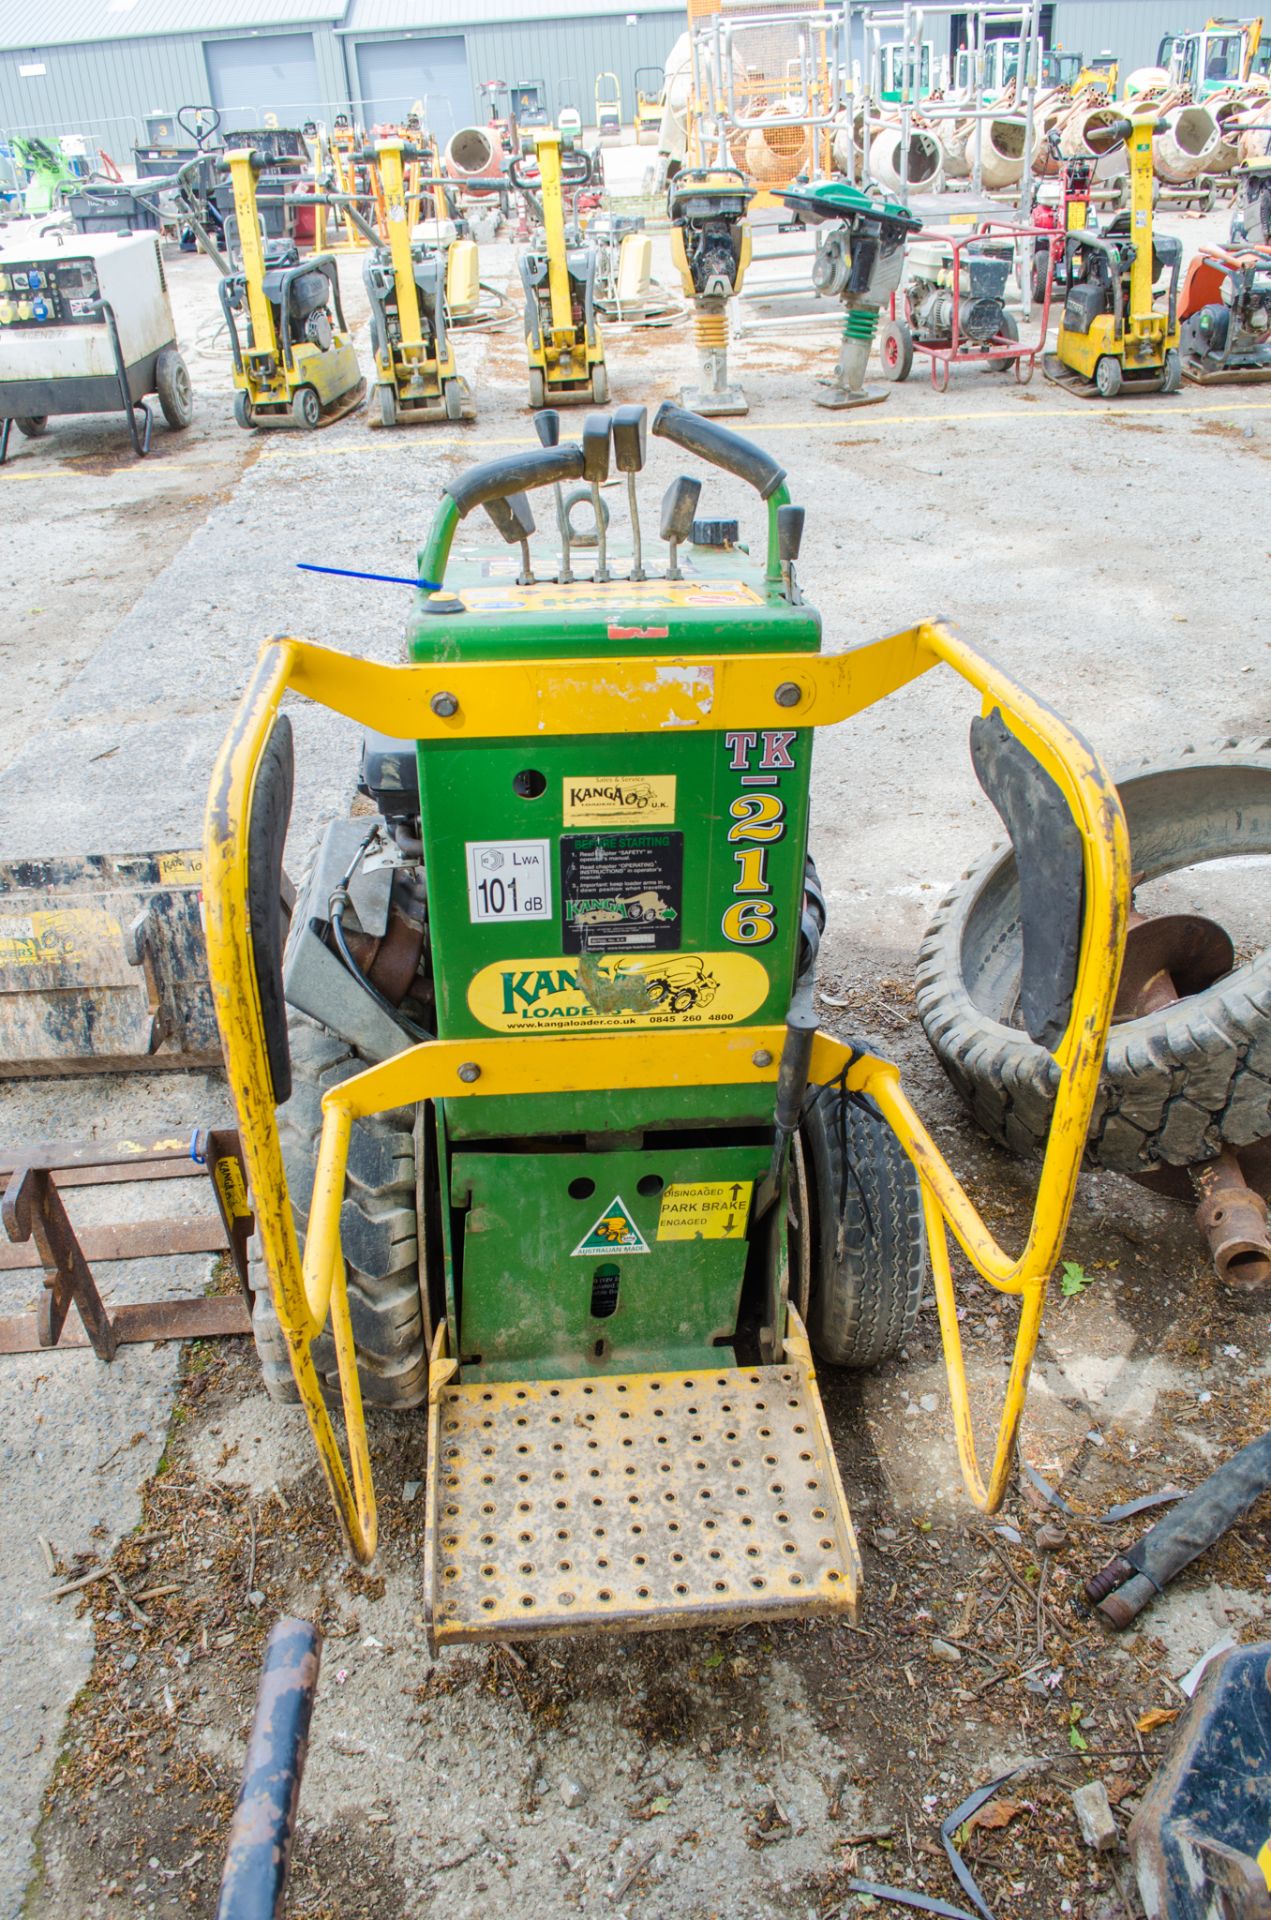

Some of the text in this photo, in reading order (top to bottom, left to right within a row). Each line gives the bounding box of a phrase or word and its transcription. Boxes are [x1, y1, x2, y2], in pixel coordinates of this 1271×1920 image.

[619, 836, 671, 848] STARTING
[478, 877, 543, 914] 101 dB
[565, 898, 629, 921] KANGA
[521, 1005, 622, 1019] LOADE
[507, 1017, 636, 1029] www.kangaloader.co.uk
[708, 1013, 734, 1021] 4800
[663, 1188, 724, 1198] DISINGAGED
[661, 1200, 747, 1213] PARK BRAKE
[660, 1218, 708, 1227] ENGAGED
[577, 1247, 622, 1255] AUSTRALIAN
